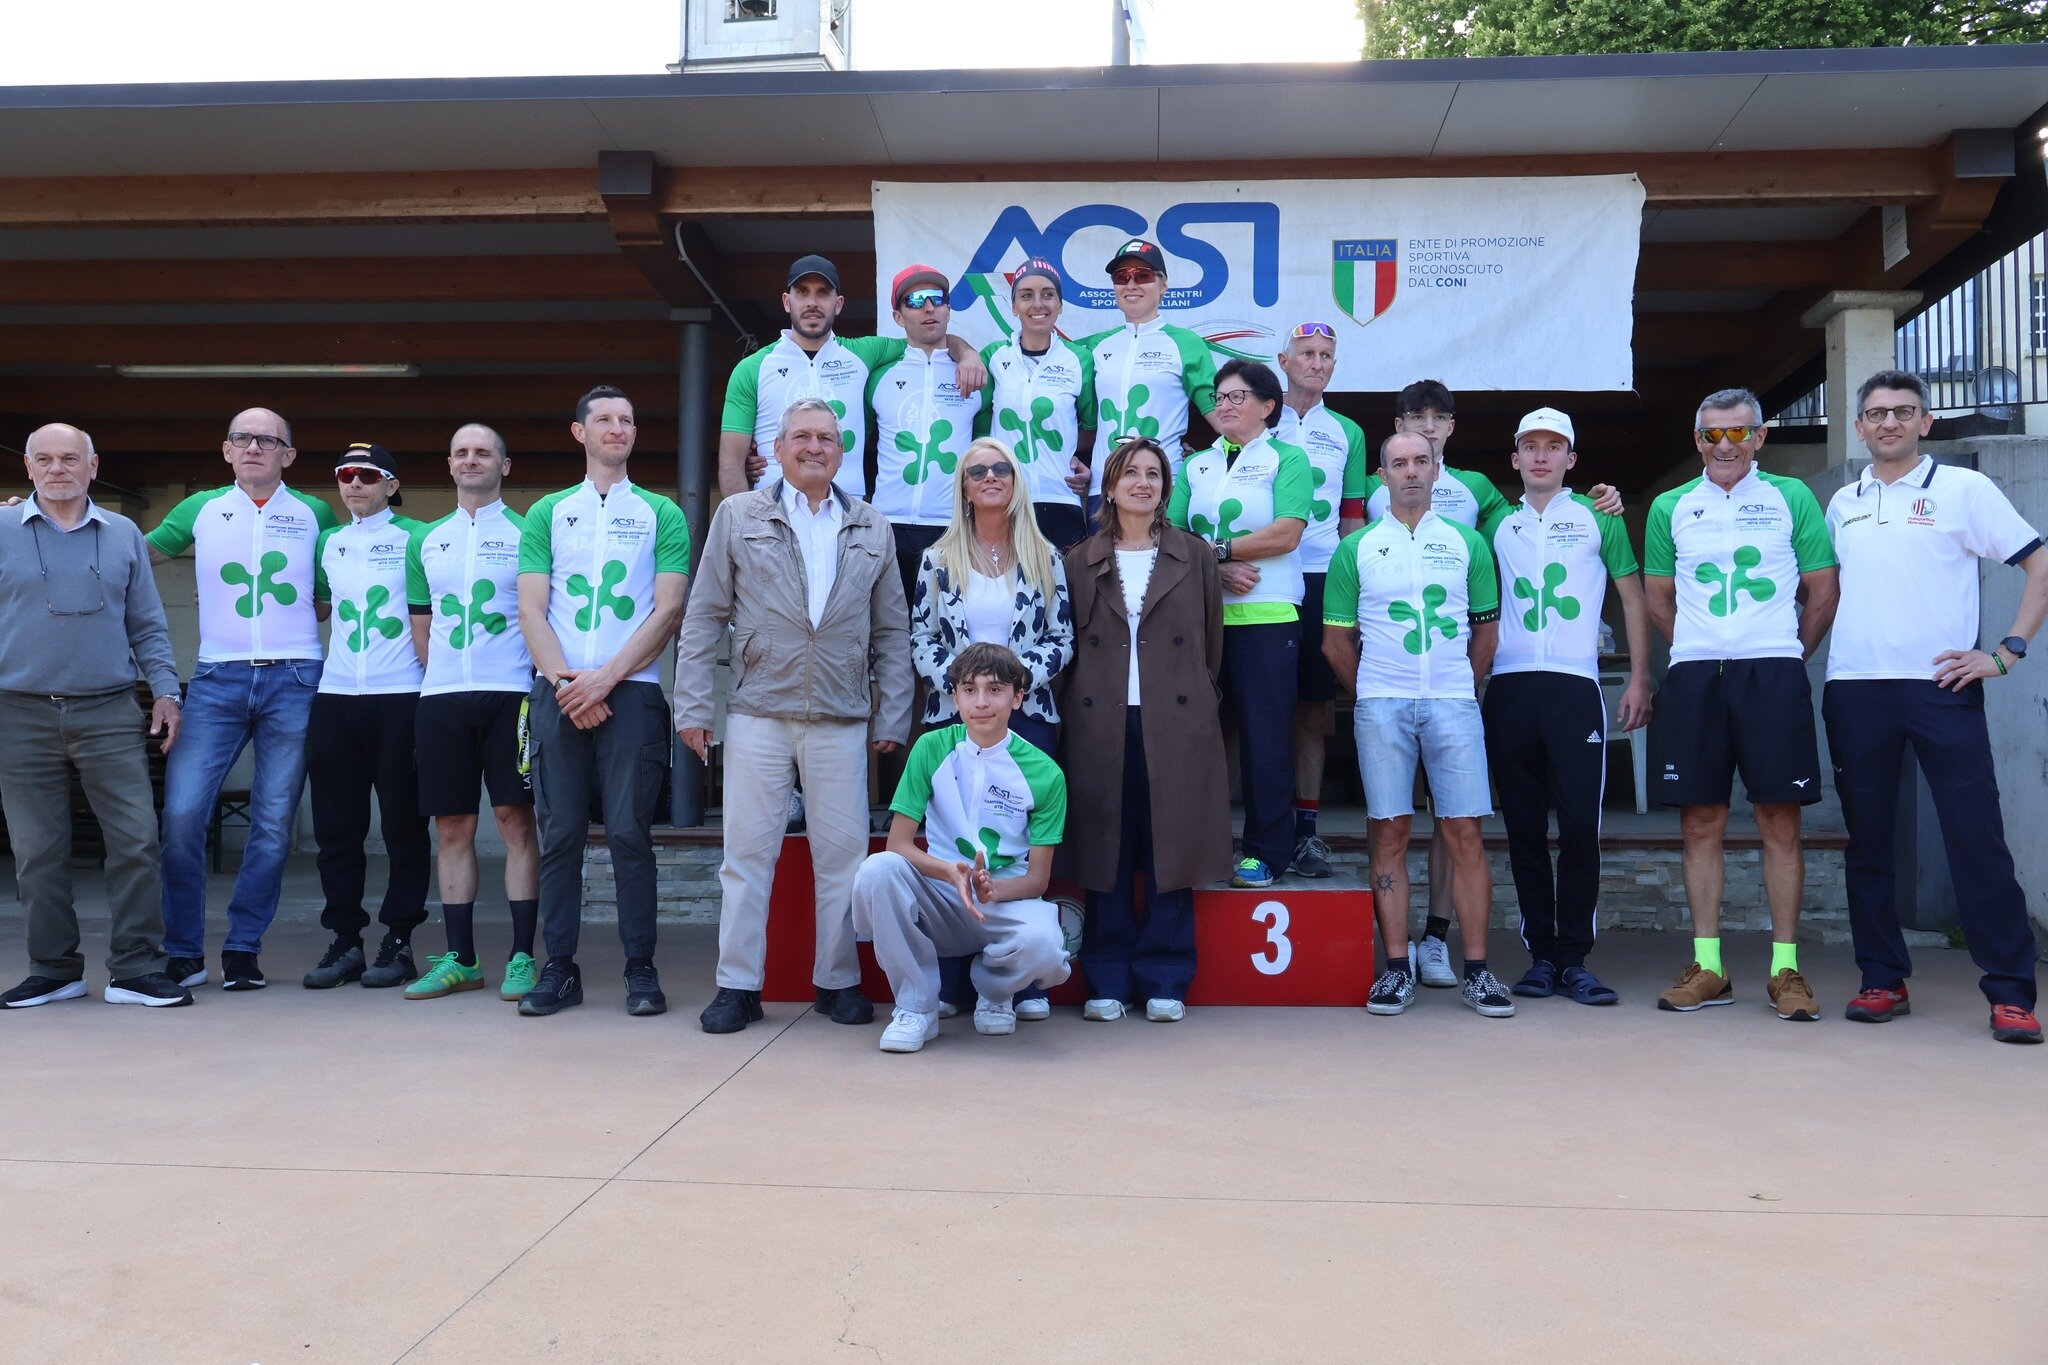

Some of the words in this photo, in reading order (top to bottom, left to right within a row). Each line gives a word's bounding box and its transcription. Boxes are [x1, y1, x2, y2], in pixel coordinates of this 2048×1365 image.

[1409, 239, 1441, 249] ENTE
[1445, 238, 1457, 248] DI
[1461, 237, 1545, 247] PROMOZIONE
[1339, 244, 1392, 257] ITALIA
[950, 202, 1279, 311] ACSI
[1409, 251, 1470, 262] SPORTIVA
[1409, 264, 1503, 275] RICONOSCIUTO
[1408, 278, 1433, 288] DAL
[1435, 278, 1467, 287] CONI
[1163, 290, 1203, 298] CENTRI
[1091, 299, 1118, 307] SPOR
[1158, 299, 1190, 307] LIANI
[821, 360, 842, 369] ACSI
[1739, 504, 1764, 512] ACSI
[1550, 522, 1573, 530] ACSI
[370, 544, 393, 553] ACSI
[988, 785, 1010, 799] ACSI
[1251, 900, 1292, 975] 3
